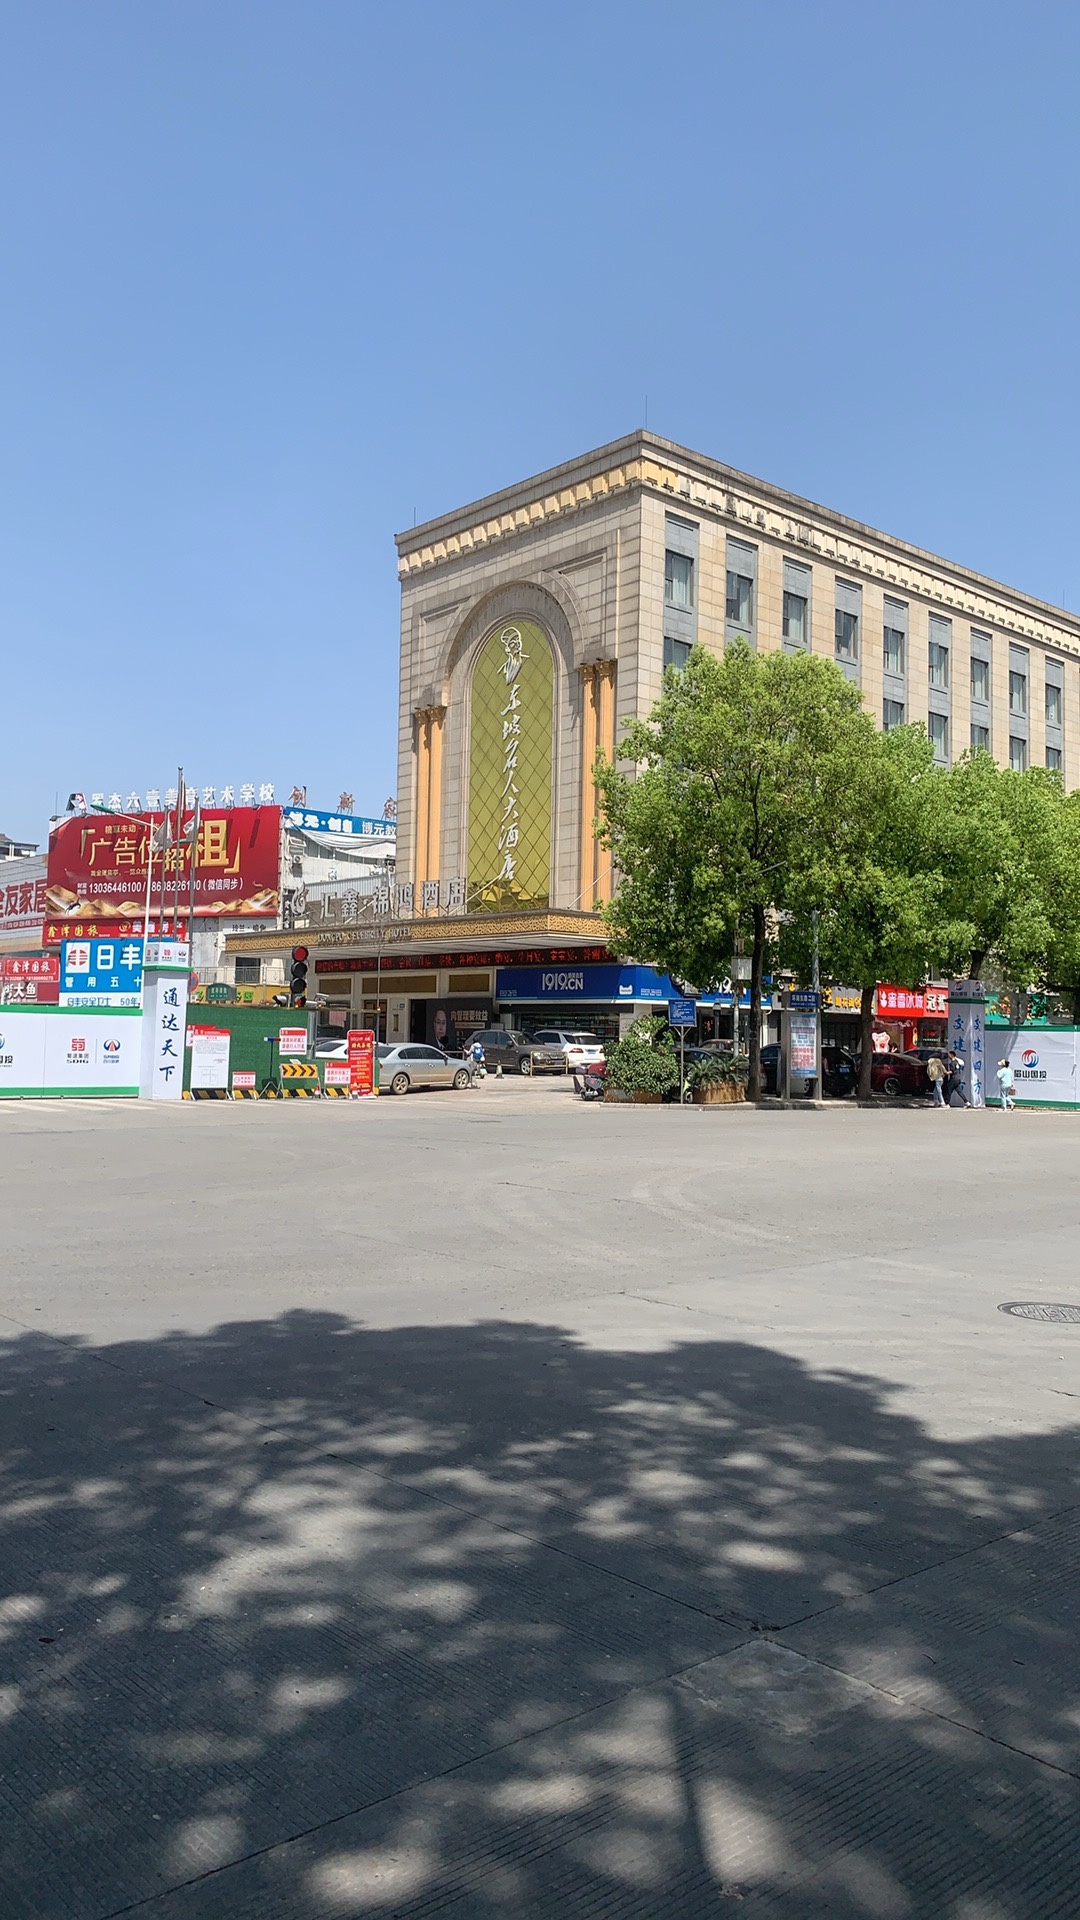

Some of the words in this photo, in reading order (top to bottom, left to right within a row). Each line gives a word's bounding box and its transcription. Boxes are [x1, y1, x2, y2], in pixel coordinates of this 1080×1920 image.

[498, 683, 521, 880] 东坡名人大酒店
[388, 927, 411, 938] HOTEL
[97, 943, 142, 971] 日丰
[542, 973, 584, 991] 1919.CN
[888, 992, 924, 1008] 蜜雪冰城
[159, 987, 181, 1081] 通达天下
[0, 1055, 14, 1065] 投
[1013, 1069, 1048, 1079] 眉山国投
